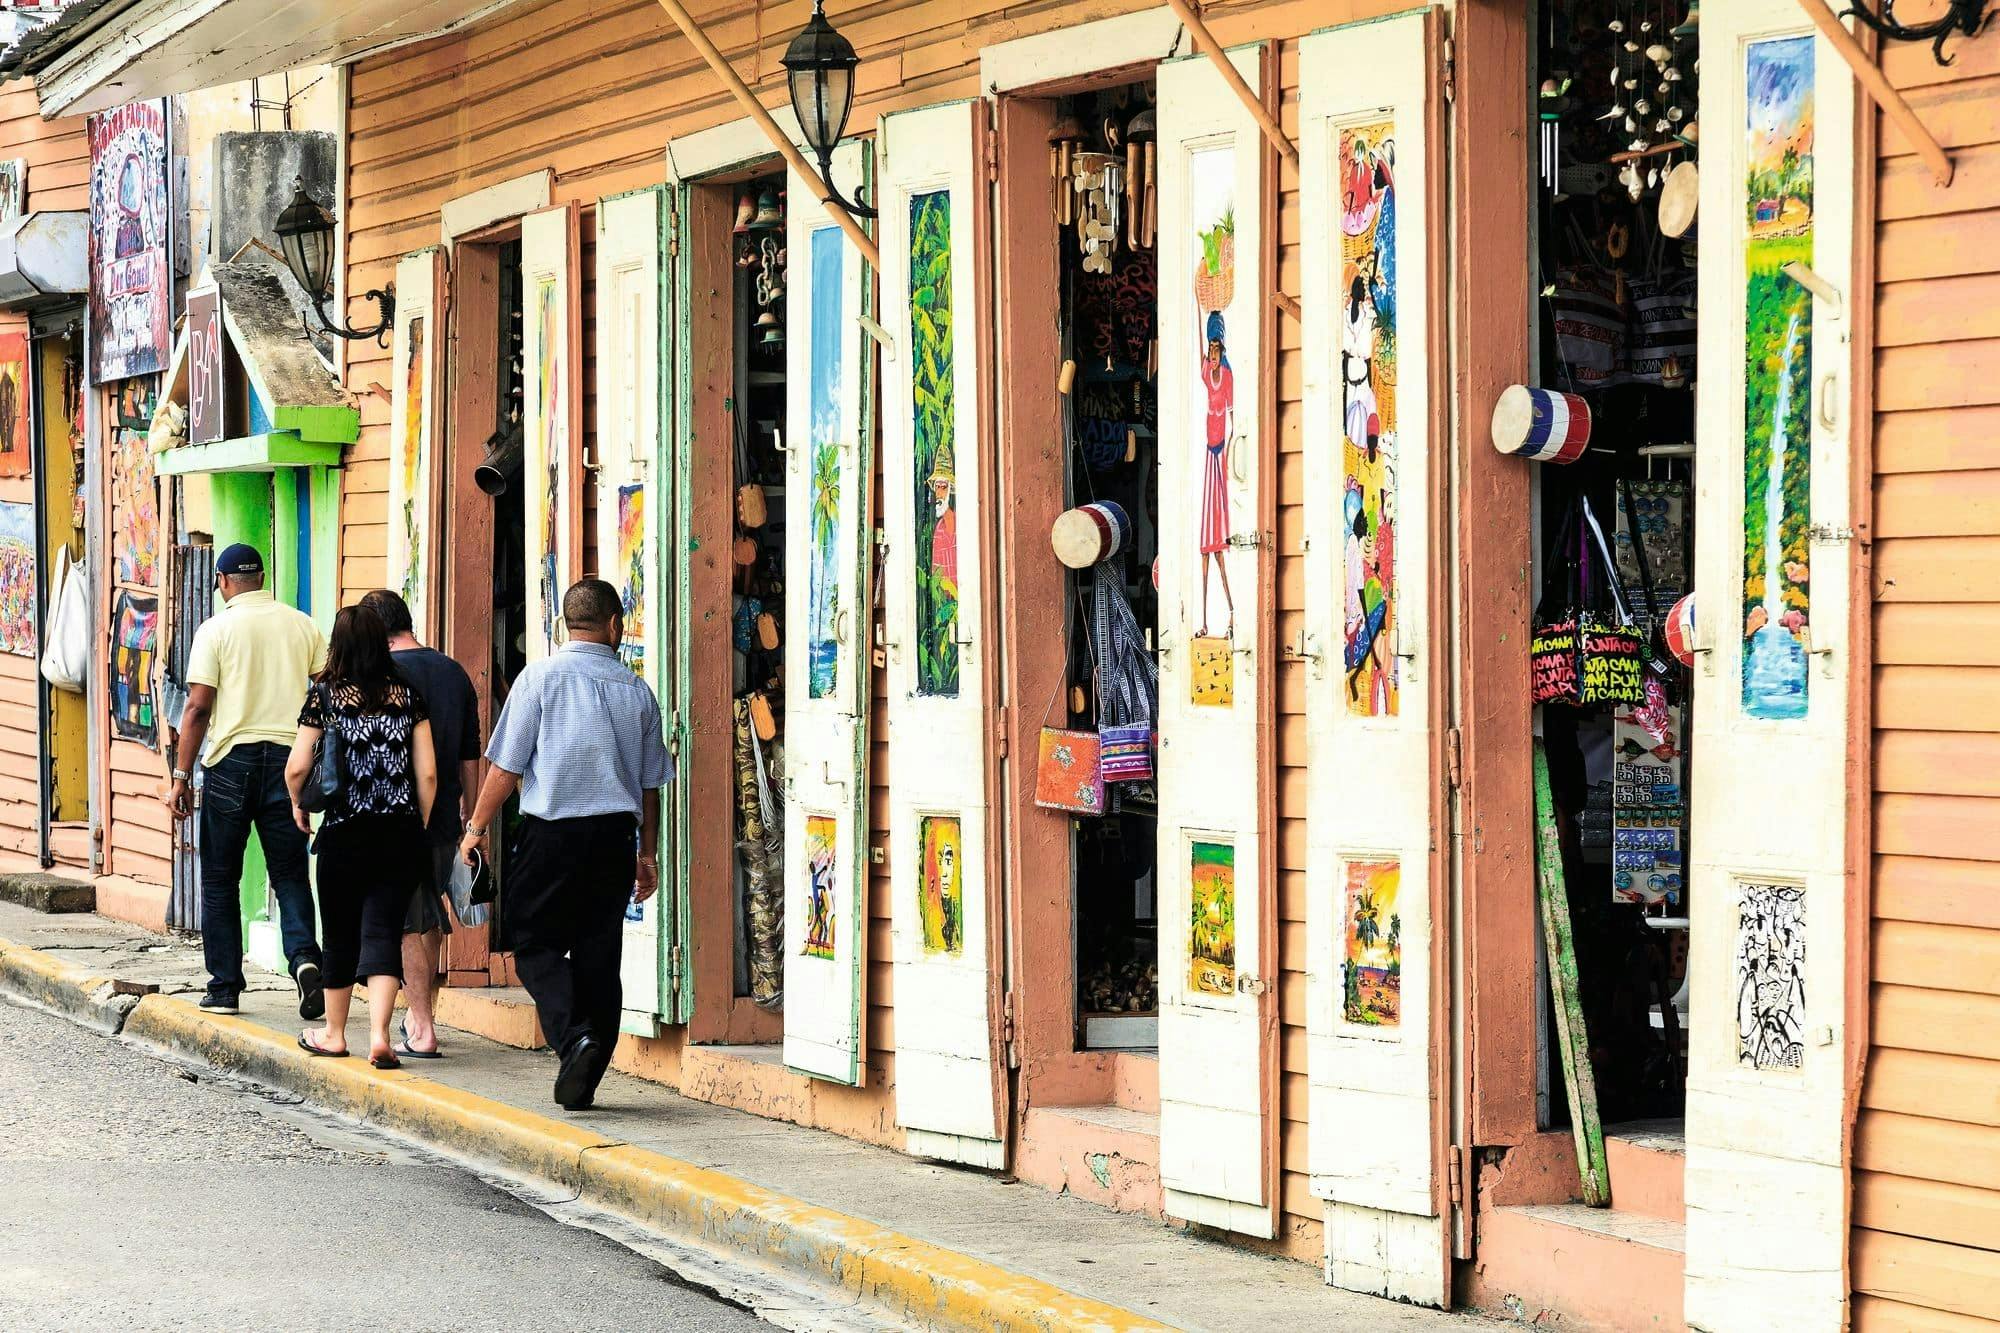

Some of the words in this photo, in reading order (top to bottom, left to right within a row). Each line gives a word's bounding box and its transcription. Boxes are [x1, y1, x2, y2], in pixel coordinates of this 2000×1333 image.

[1544, 636, 1574, 651] CANA
[1536, 653, 1565, 670] CANA
[1609, 657, 1641, 673] CANA
[1537, 667, 1577, 687] PUNTA
[1597, 687, 1634, 701] CANA
[1618, 771, 1633, 780] RD
[1636, 774, 1651, 783] RD
[1654, 775, 1669, 783] RD
[1618, 794, 1632, 802] RD
[1636, 793, 1651, 801] RD
